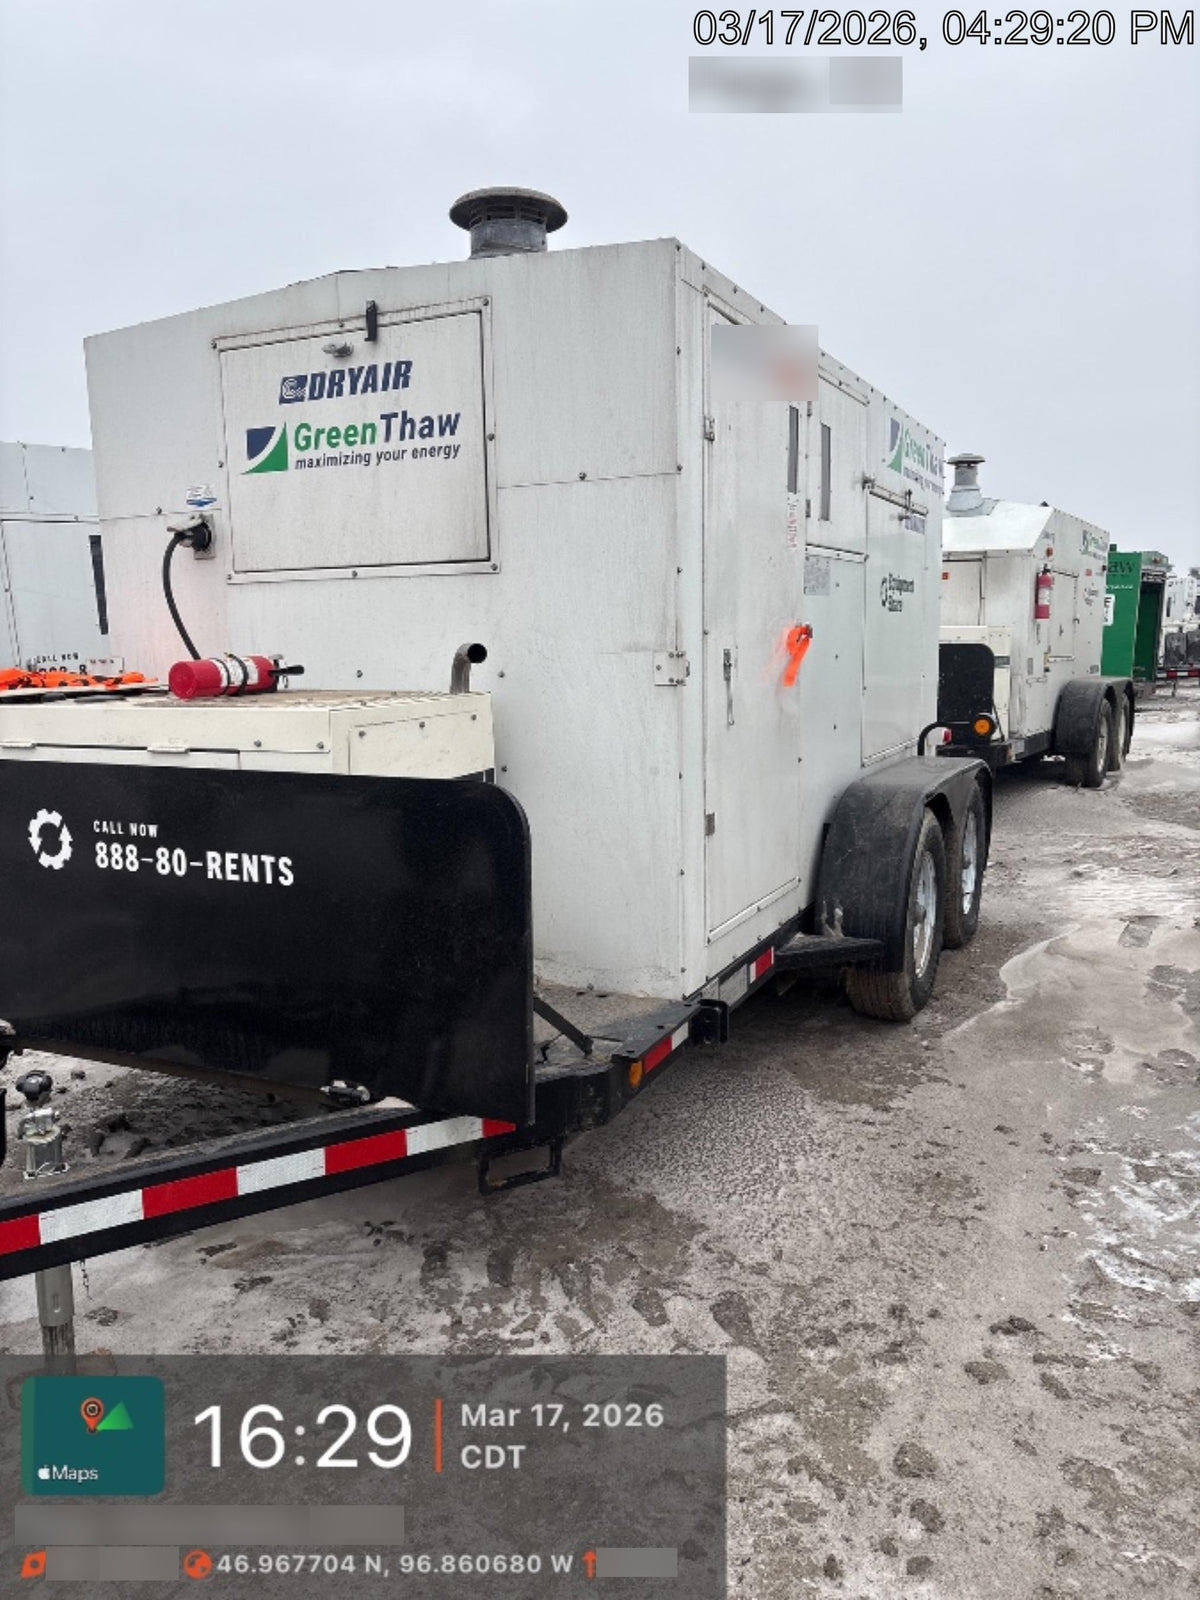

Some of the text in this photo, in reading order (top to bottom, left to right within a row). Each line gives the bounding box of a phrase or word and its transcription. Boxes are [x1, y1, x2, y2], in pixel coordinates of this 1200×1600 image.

[307, 360, 413, 400] DRYAIR
[294, 410, 461, 452] GreenThaw
[295, 443, 461, 470] maximizing your energy
[93, 820, 158, 838] CALL NOW
[95, 841, 294, 887] 888-80-RENTS
